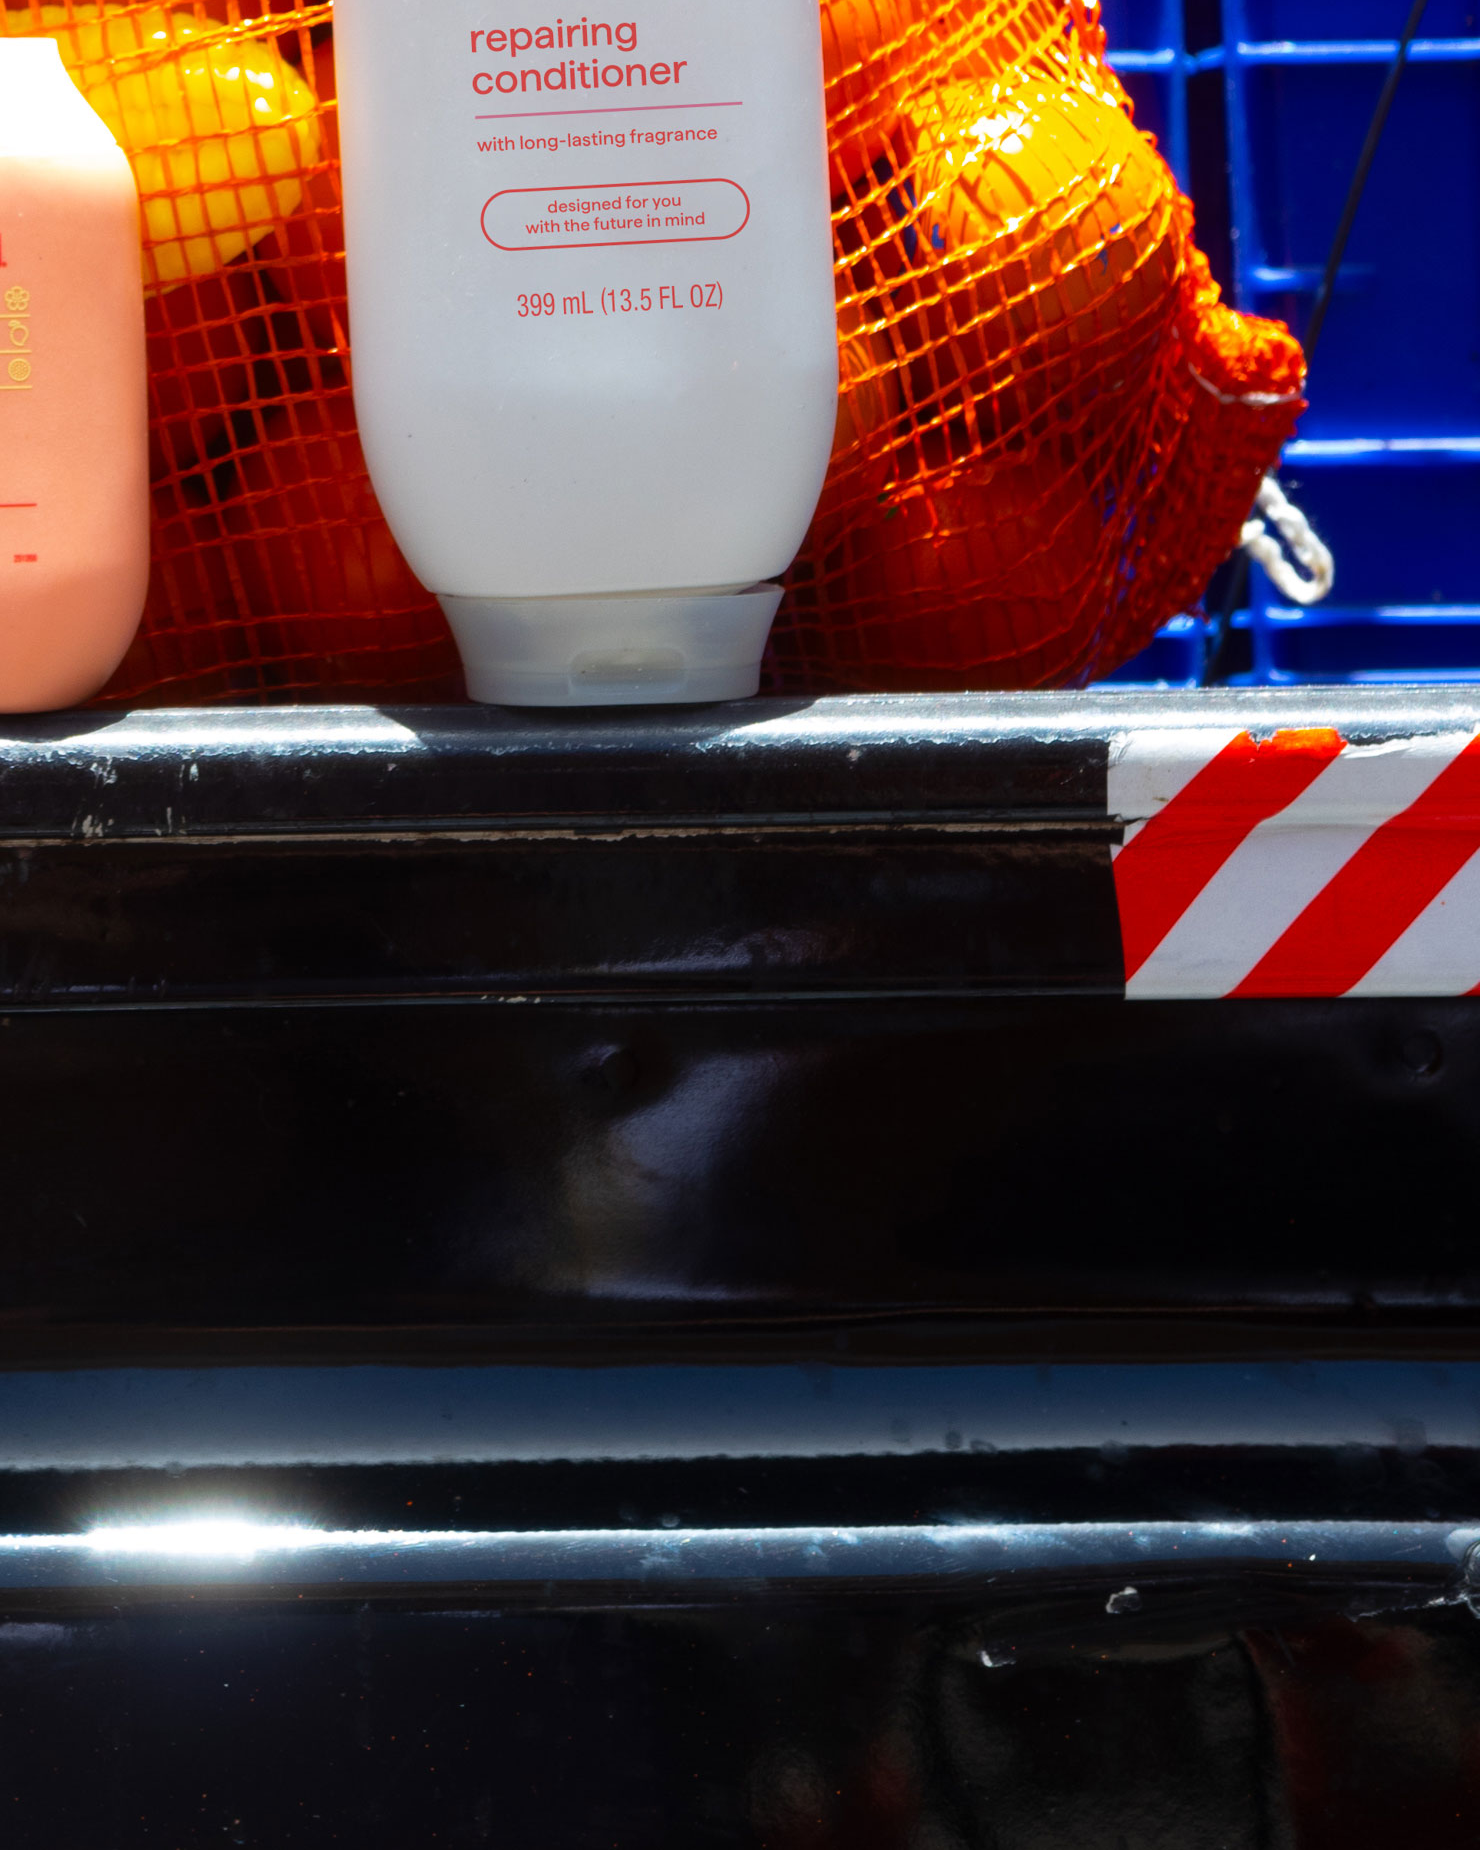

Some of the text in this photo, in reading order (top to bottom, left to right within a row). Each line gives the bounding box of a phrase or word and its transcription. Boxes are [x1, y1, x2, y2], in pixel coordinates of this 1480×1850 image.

[471, 17, 637, 57] repairing
[473, 59, 687, 94] conditioner
[477, 129, 717, 152] with long-lasting fragrance
[548, 196, 681, 214] designed for you
[526, 212, 704, 234] with the future in mind
[517, 281, 722, 317] 399 mL (13.5 FL OZ)
